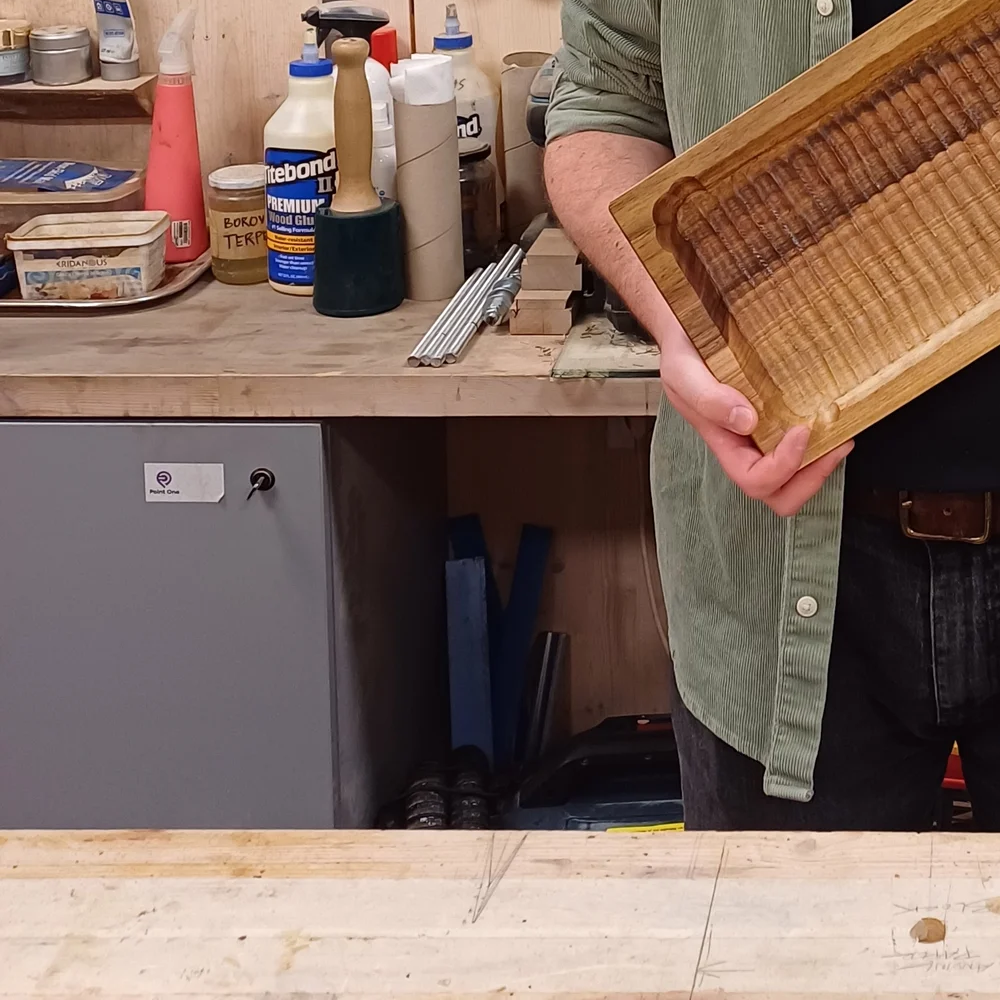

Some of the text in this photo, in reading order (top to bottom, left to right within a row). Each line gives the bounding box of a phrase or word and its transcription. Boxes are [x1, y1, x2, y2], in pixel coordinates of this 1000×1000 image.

[457, 116, 479, 137] nd
[265, 151, 337, 184] Titebond
[318, 176, 332, 193] II
[269, 213, 315, 226] Wood Glu
